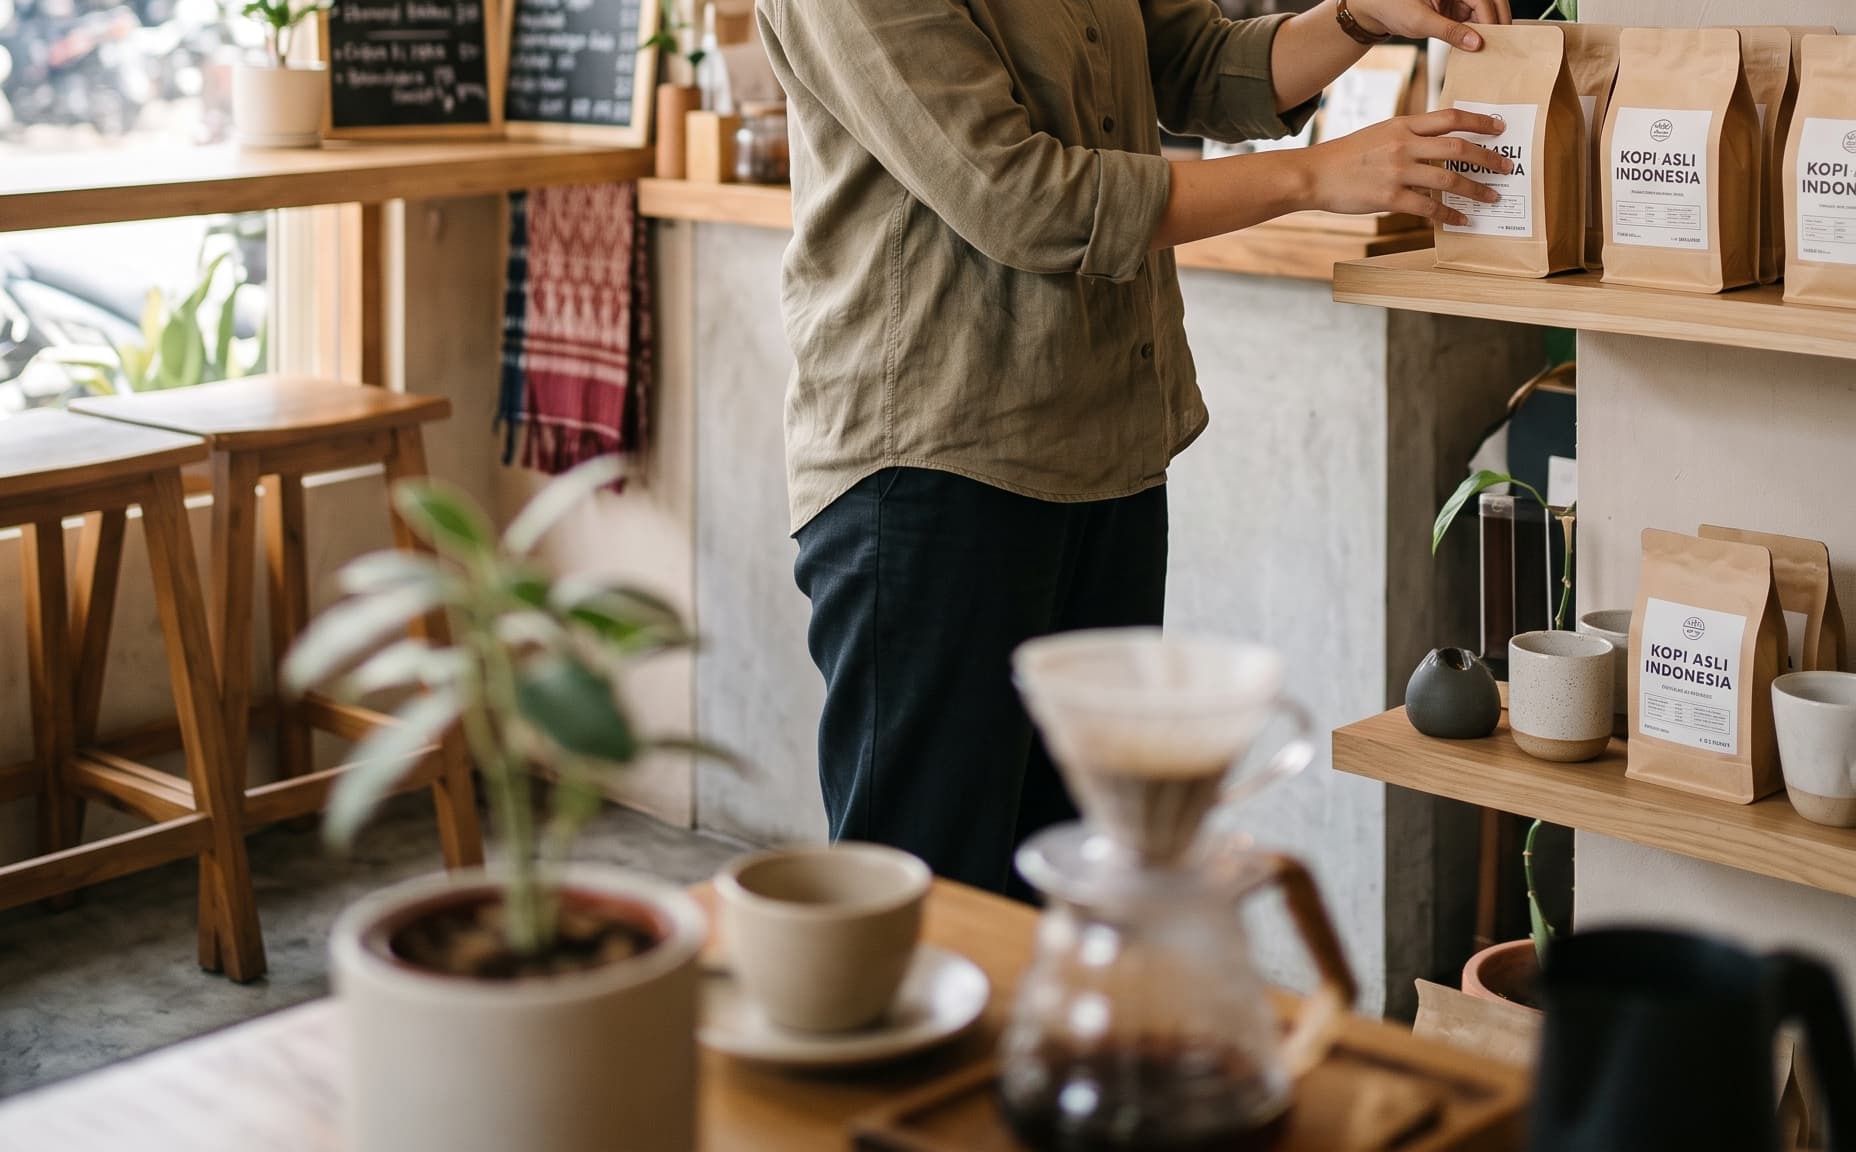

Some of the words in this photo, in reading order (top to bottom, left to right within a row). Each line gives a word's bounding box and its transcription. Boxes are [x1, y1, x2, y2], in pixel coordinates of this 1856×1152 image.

[1620, 150, 1657, 165] KOPI
[1662, 153, 1696, 167] ASLI
[1616, 167, 1701, 185] INDONESIA
[1807, 161, 1849, 177] KOPI
[1651, 643, 1688, 663] KOPI
[1692, 653, 1728, 672] ASLI
[1645, 660, 1732, 690] INDONESIA
